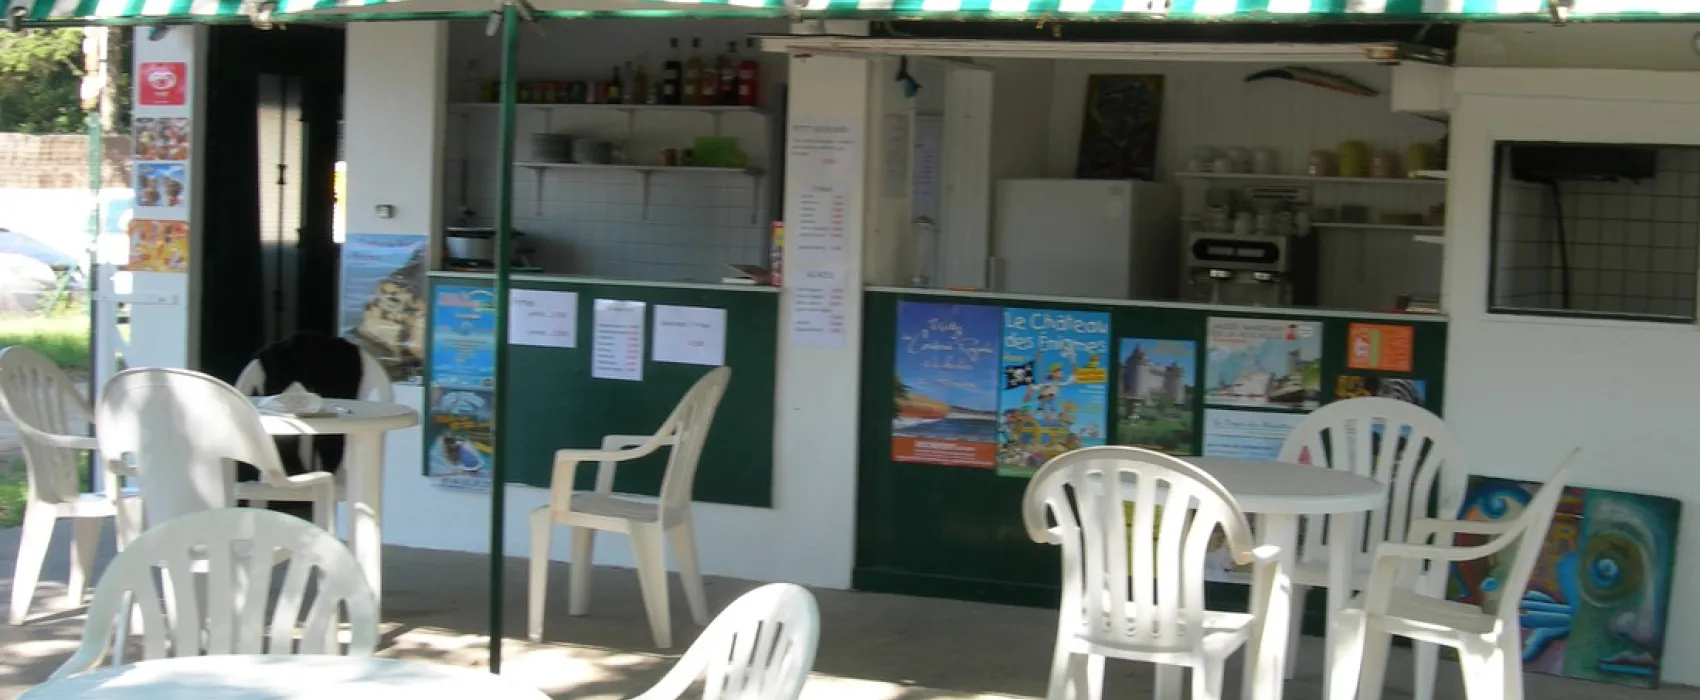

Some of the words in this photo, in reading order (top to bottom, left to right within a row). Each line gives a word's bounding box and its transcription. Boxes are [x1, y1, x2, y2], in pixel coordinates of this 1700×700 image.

[1004, 311, 1027, 330] Le
[1028, 313, 1109, 334] Château
[1003, 331, 1034, 351] des
